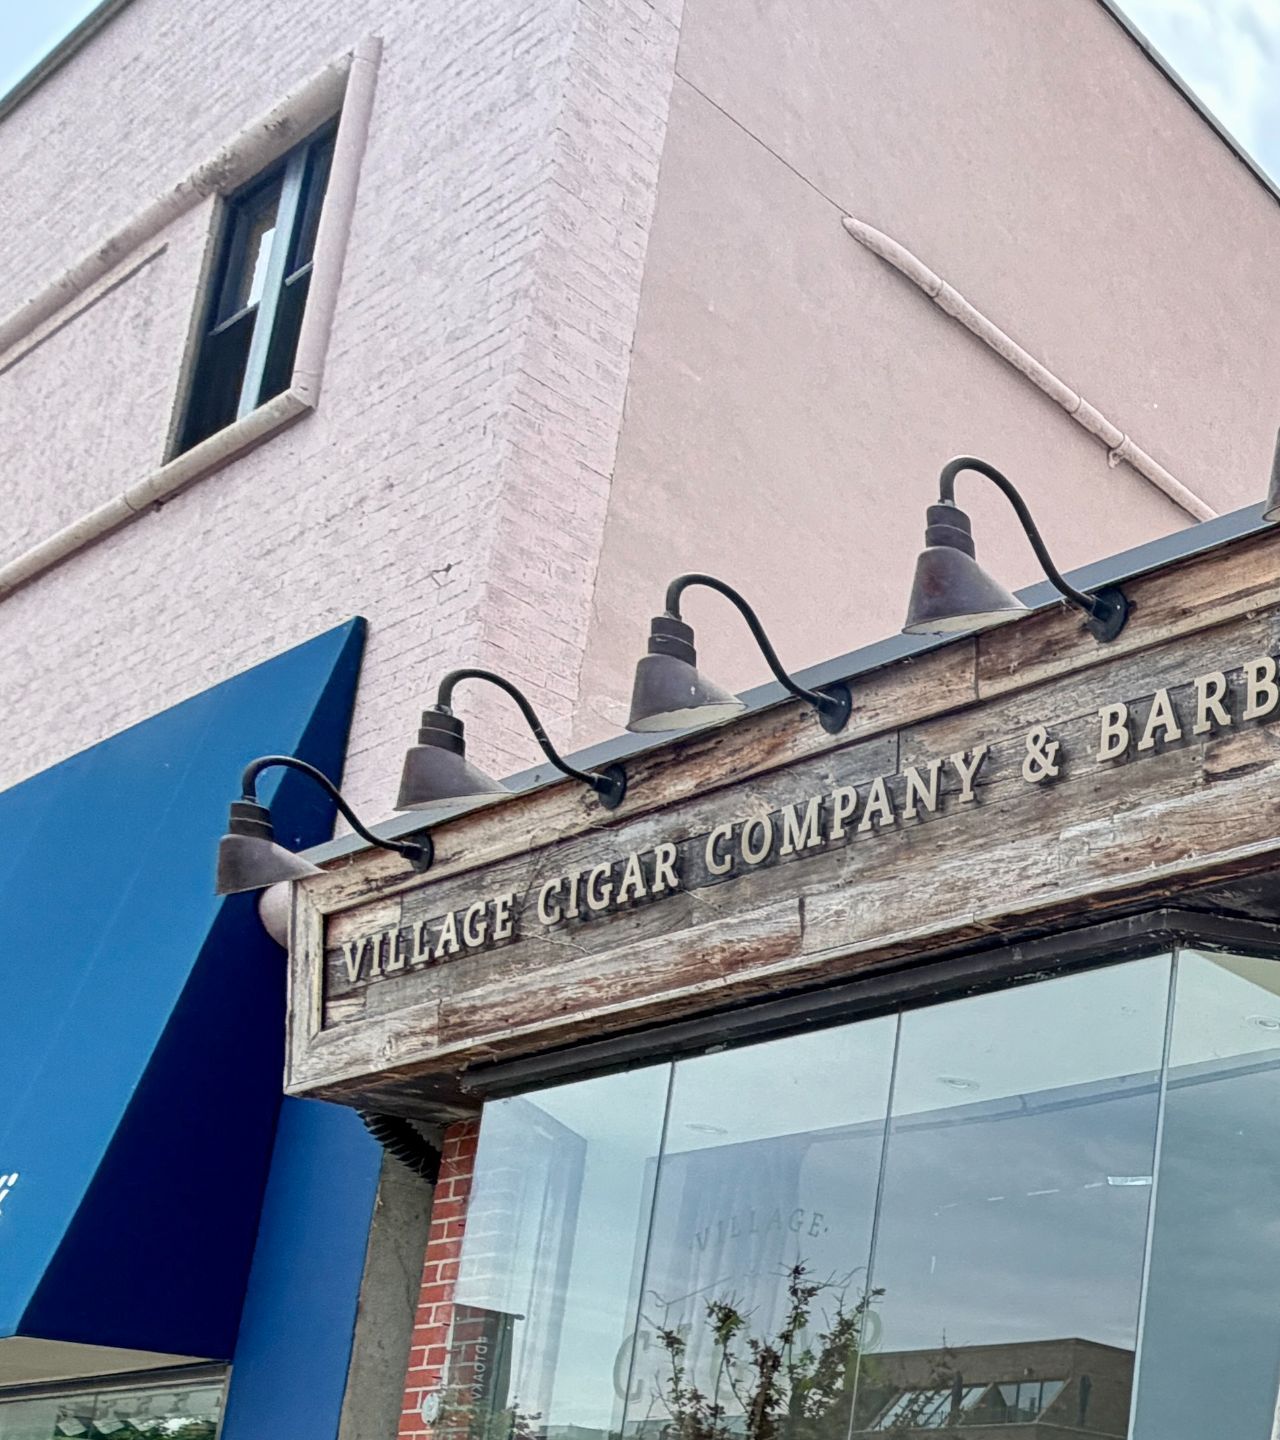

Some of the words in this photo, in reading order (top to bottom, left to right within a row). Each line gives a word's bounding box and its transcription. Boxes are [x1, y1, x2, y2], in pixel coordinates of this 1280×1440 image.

[342, 894, 517, 983] VILLAGE
[537, 843, 680, 926] CIGAR
[705, 747, 988, 876] COMPANY
[1021, 725, 1061, 783] &
